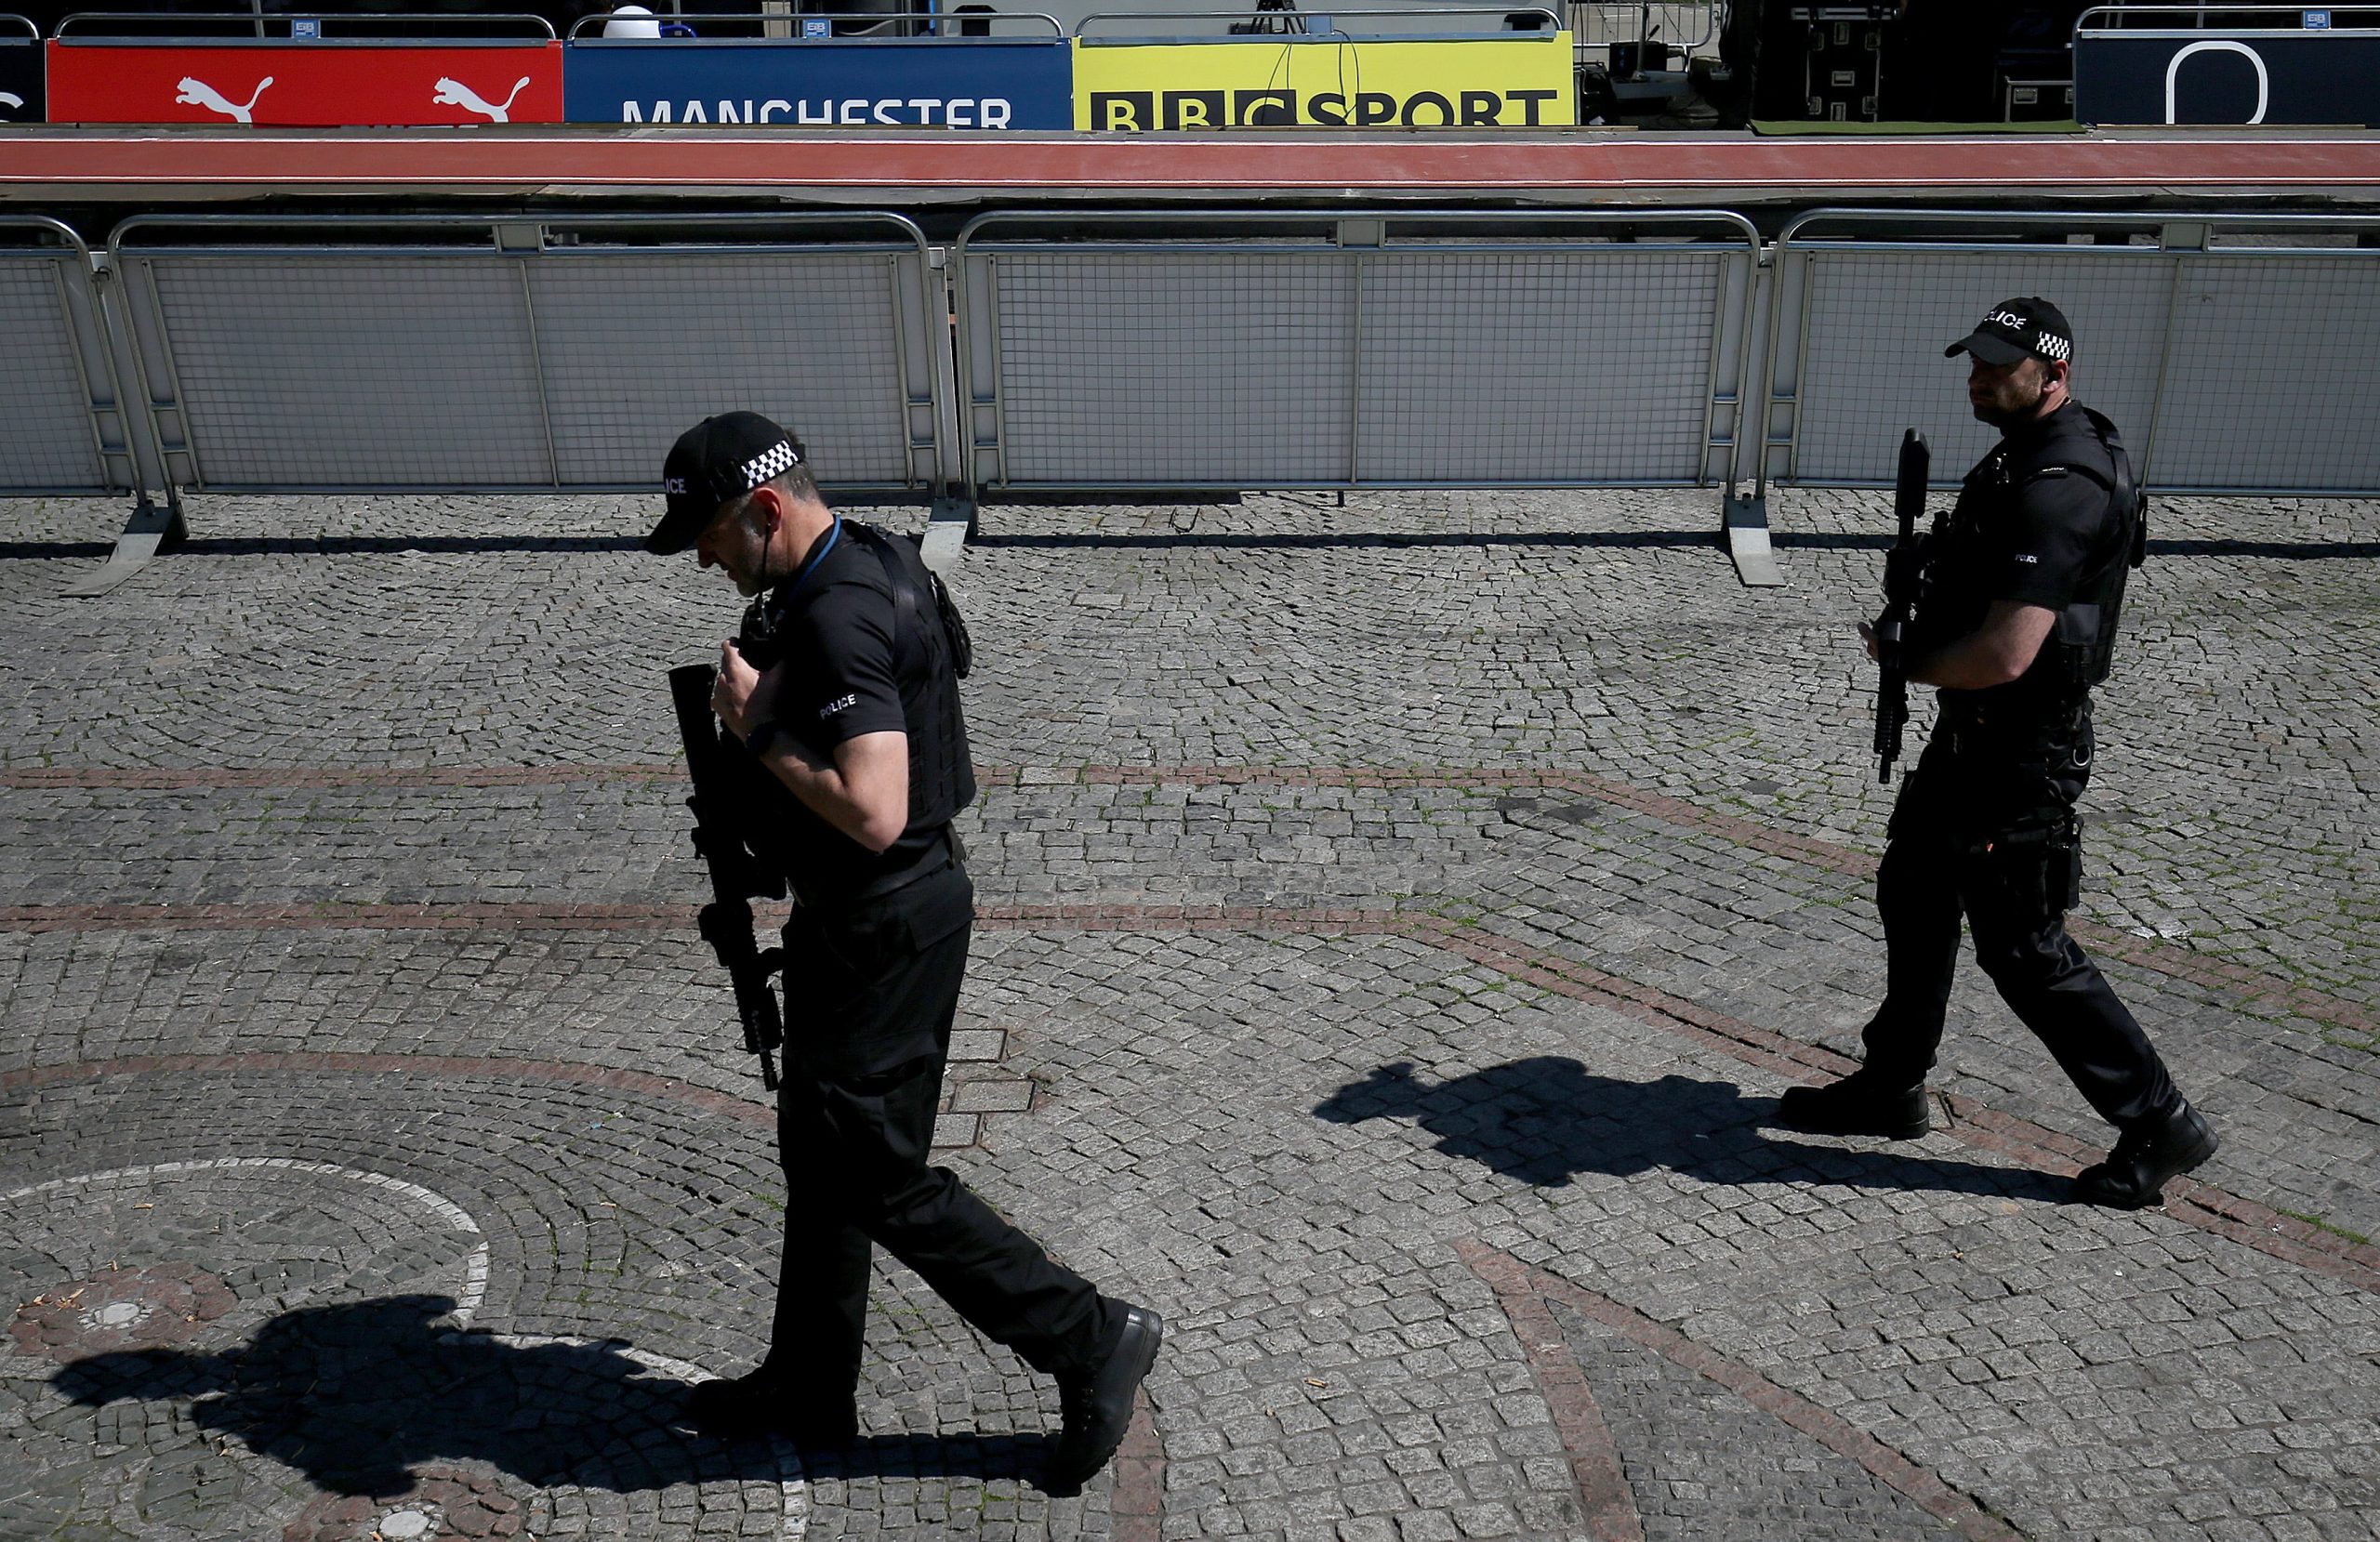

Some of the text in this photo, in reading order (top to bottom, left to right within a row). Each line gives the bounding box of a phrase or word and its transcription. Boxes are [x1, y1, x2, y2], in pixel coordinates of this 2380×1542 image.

[622, 98, 1012, 129] MANCHESTER
[1092, 89, 1558, 131] BBC SPORT
[819, 693, 856, 720] POLICE
